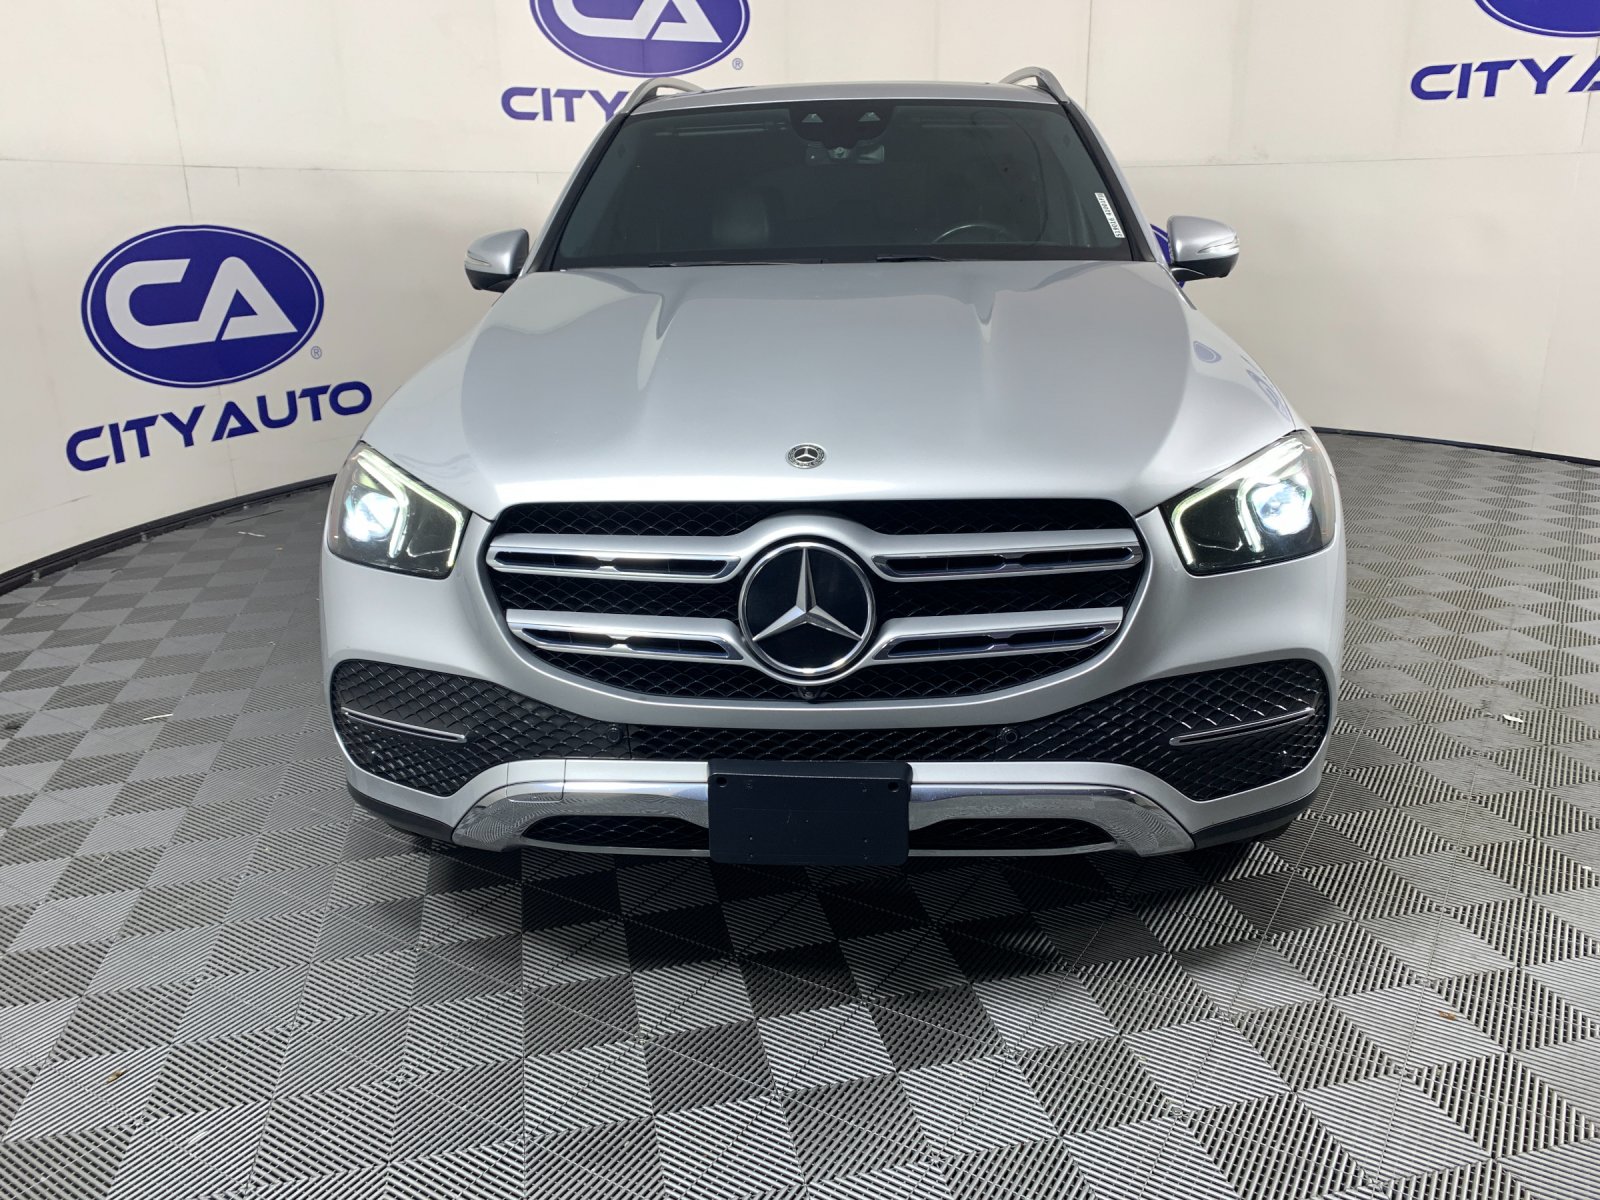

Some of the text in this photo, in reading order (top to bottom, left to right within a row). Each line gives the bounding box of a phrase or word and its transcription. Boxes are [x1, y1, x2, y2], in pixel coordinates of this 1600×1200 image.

[501, 86, 632, 122] CITY
[1411, 55, 1576, 100] CITY
[105, 256, 298, 349] CA
[66, 381, 372, 472] CITY AUTO
